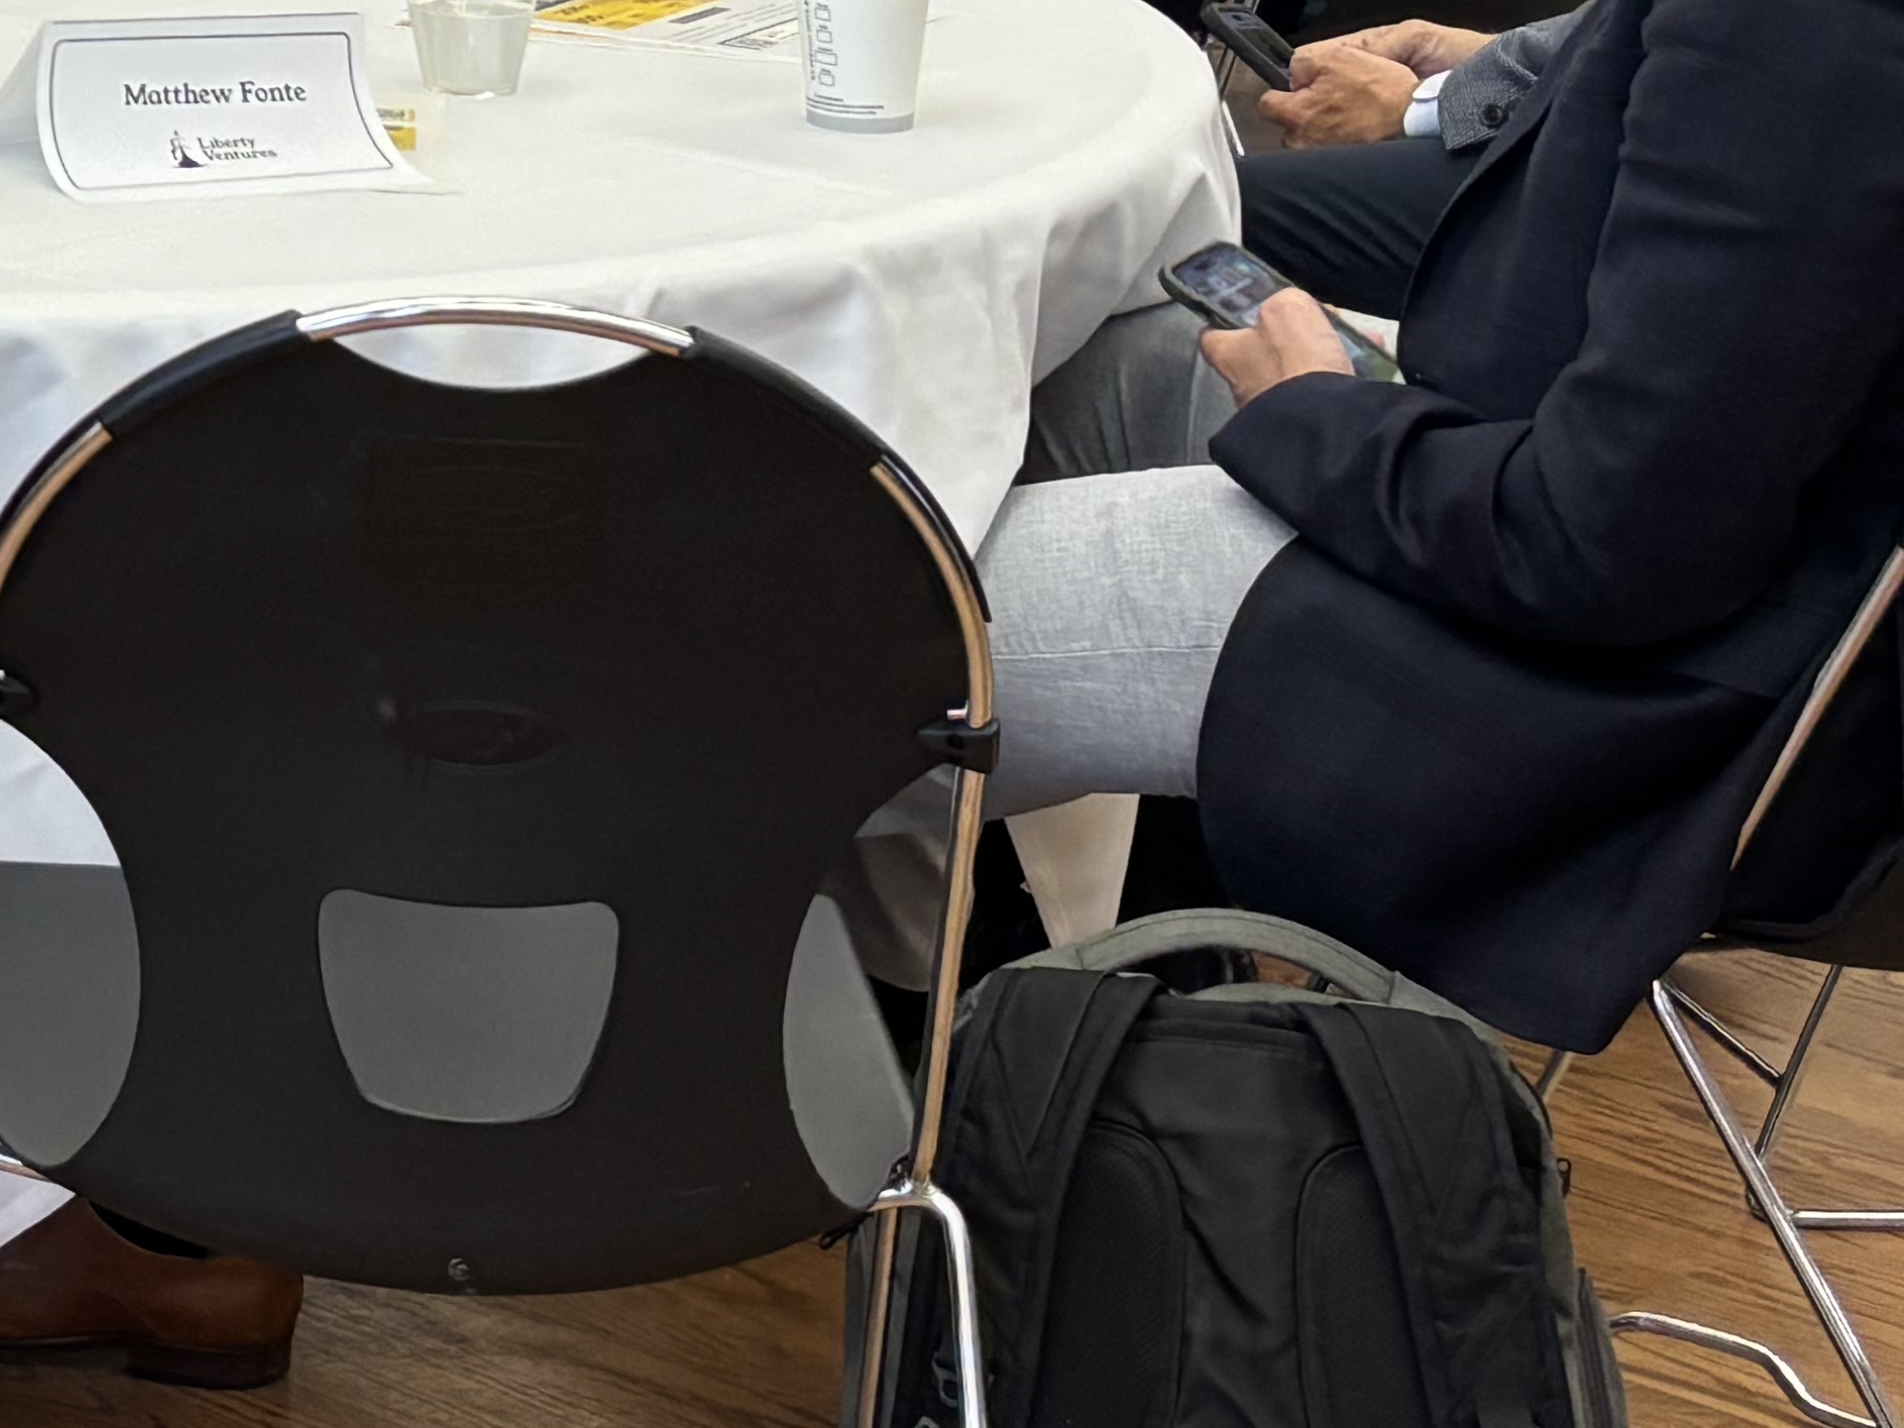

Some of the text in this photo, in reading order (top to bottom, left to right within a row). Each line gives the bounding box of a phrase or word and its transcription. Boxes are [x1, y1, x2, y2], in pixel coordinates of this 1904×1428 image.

[123, 80, 308, 107] Matthew Fonte
[196, 136, 256, 150] Liberty
[202, 148, 278, 162] Ventures
